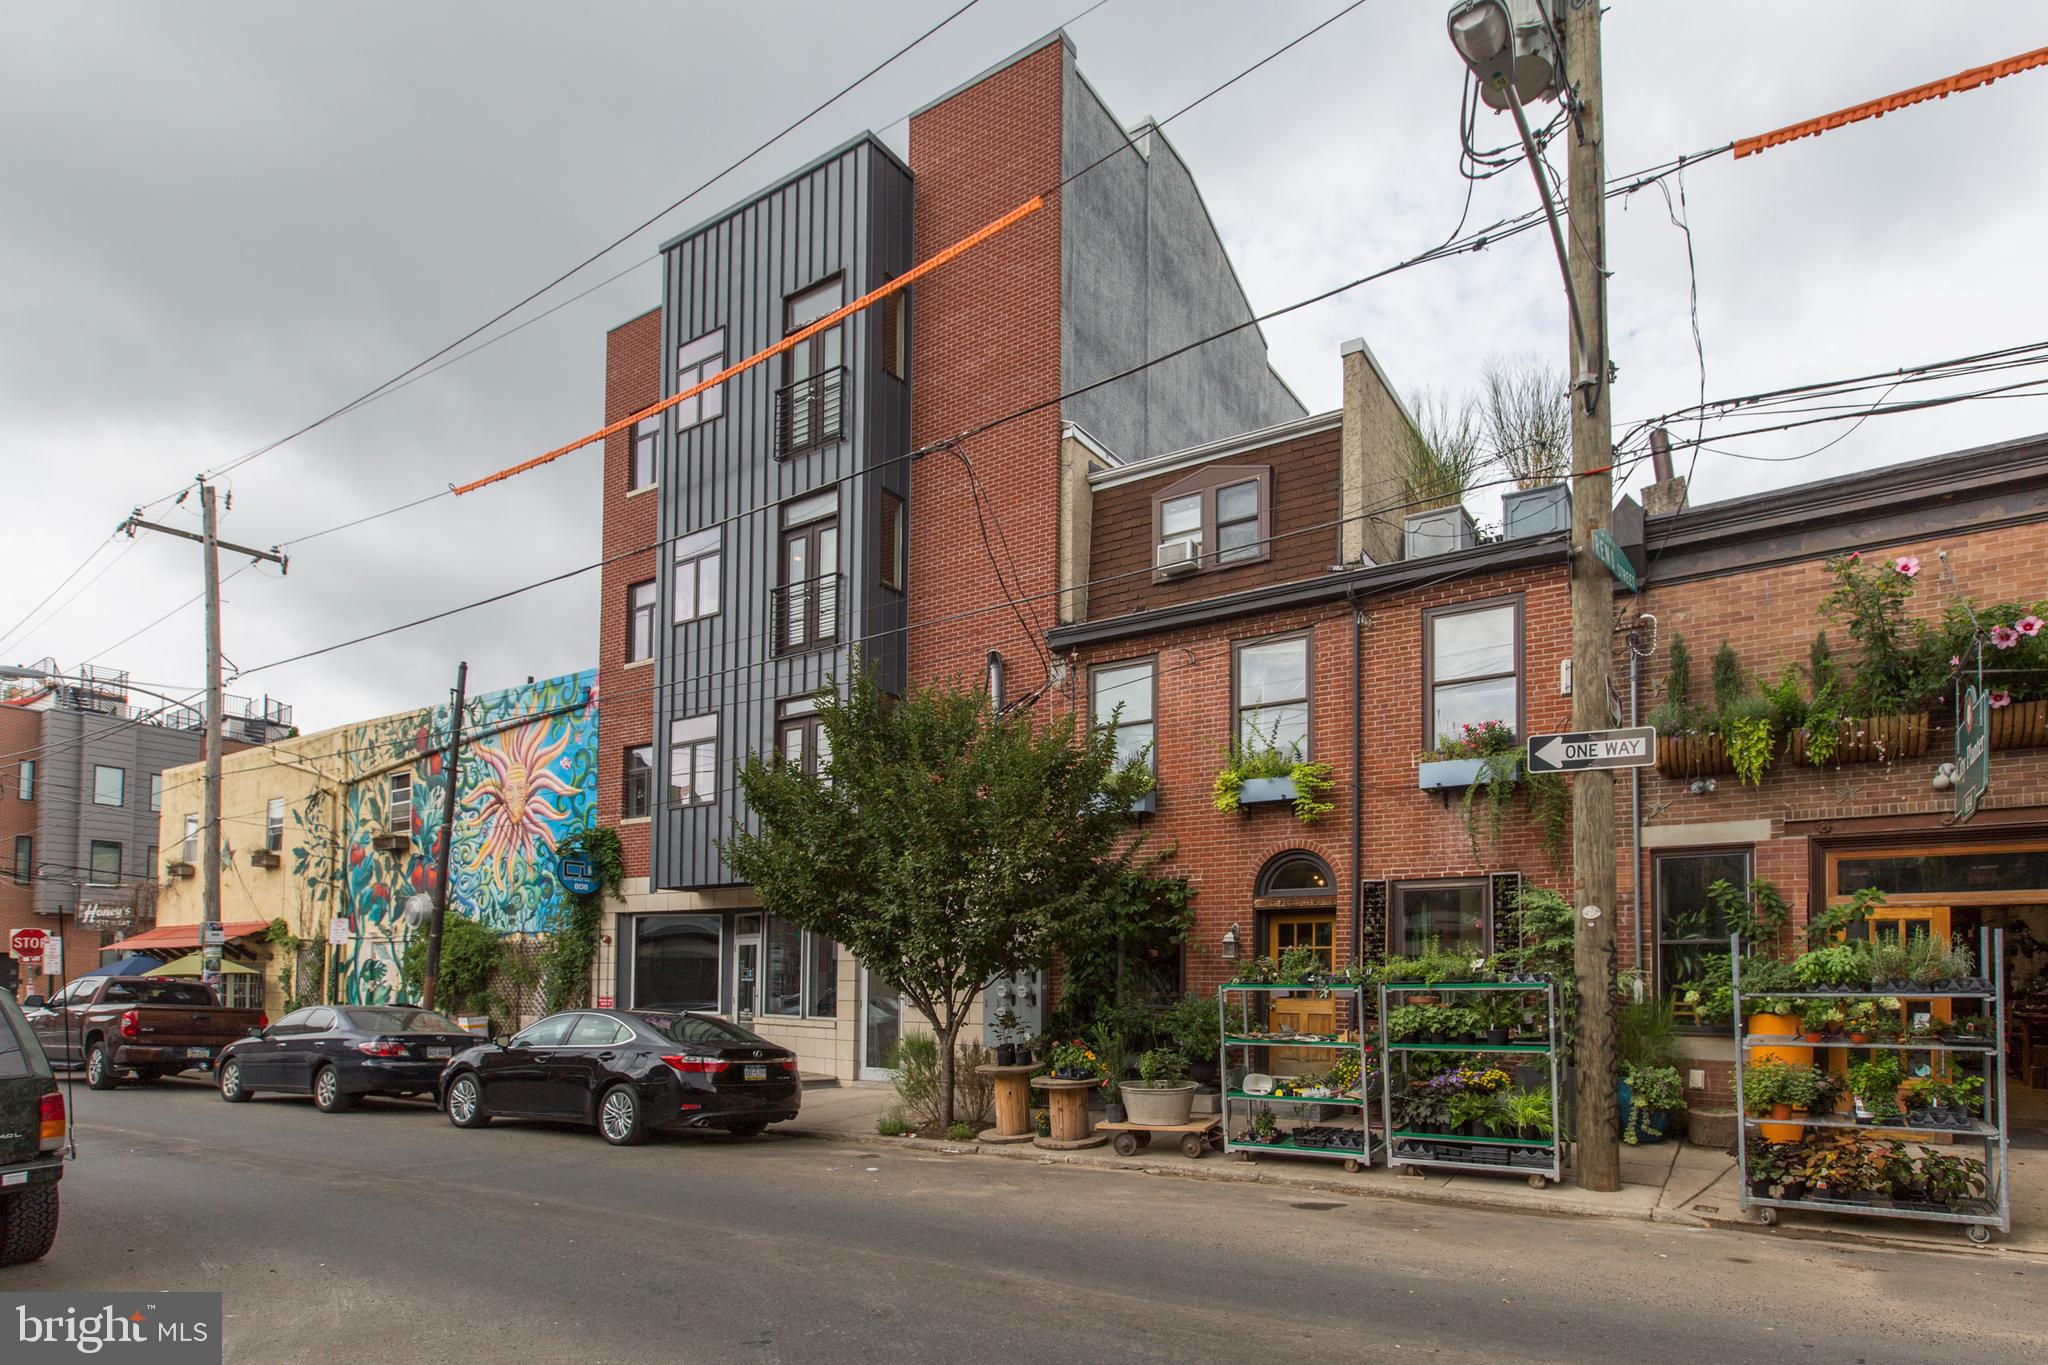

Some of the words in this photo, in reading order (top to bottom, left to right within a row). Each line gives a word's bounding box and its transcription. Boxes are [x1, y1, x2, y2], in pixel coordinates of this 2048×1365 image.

[1616, 563, 1636, 588] STREET
[1565, 743, 1599, 759] ONE
[1605, 740, 1641, 756] WAY
[1966, 734, 1984, 769] Planter
[82, 903, 131, 924] Honey's
